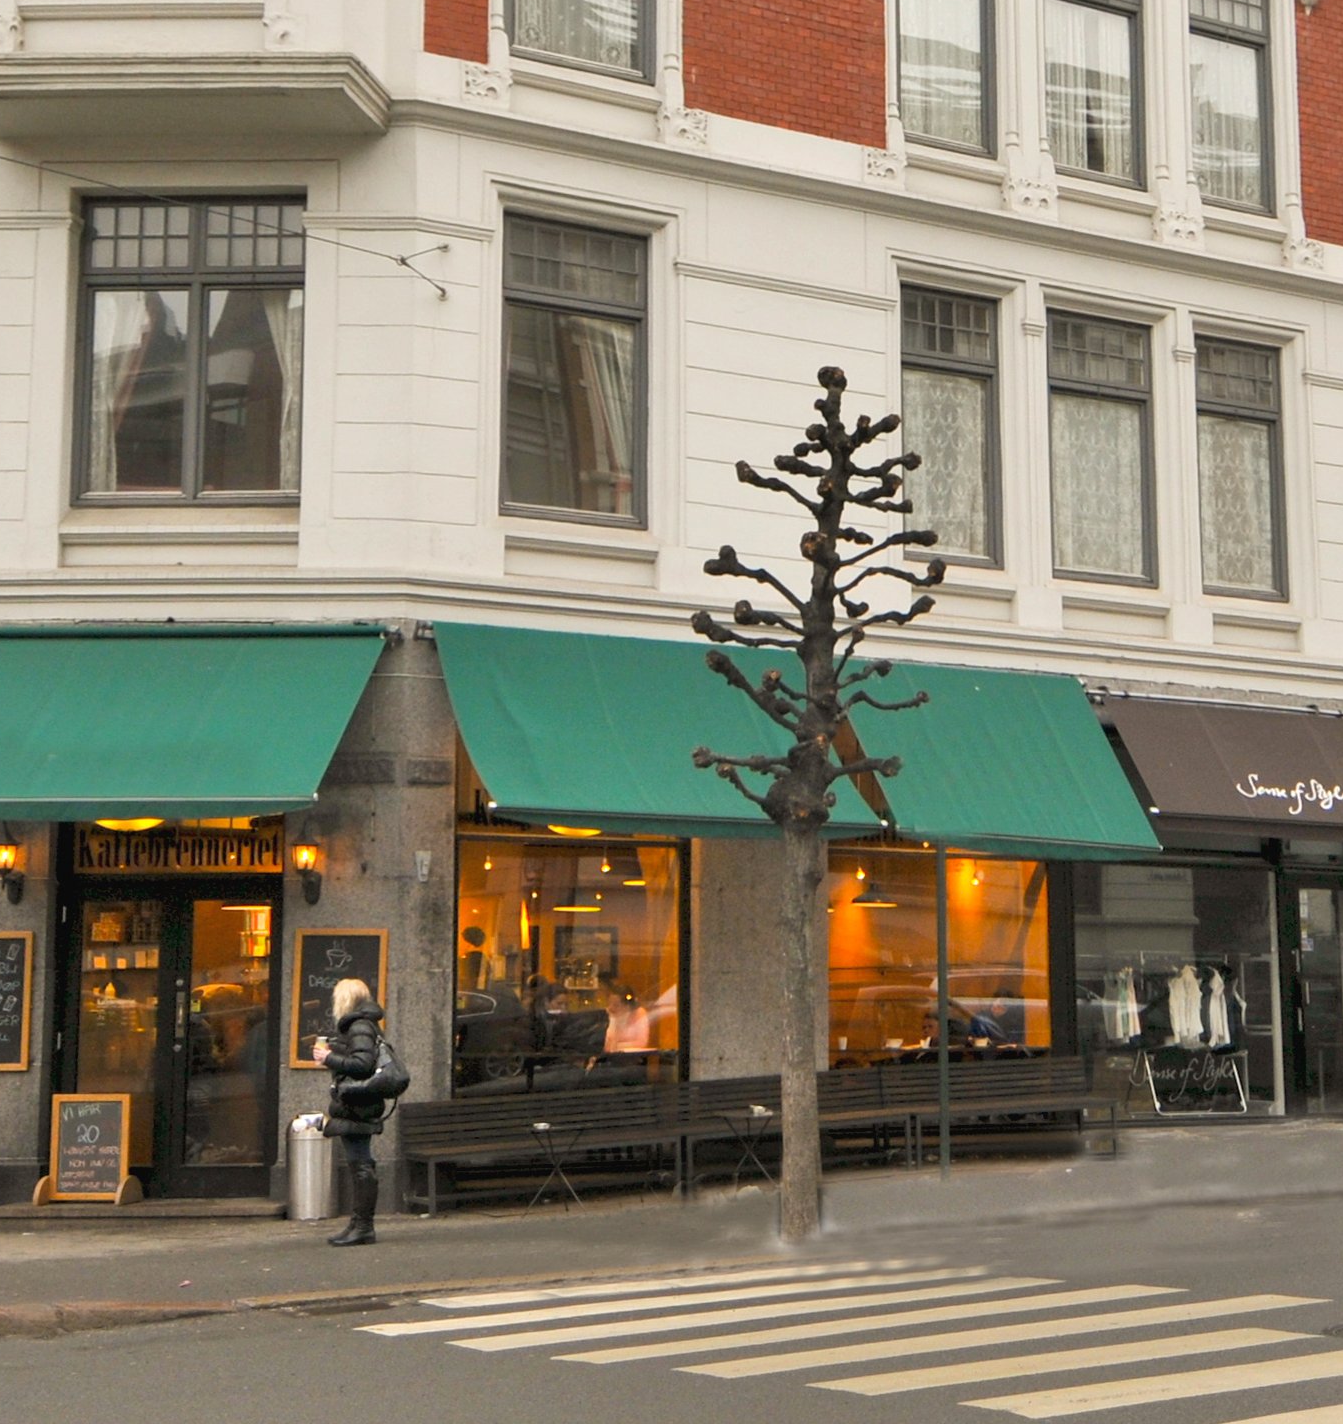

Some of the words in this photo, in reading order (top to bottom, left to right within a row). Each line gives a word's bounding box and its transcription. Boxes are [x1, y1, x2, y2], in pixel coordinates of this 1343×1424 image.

[1289, 782, 1305, 815] of
[78, 828, 280, 868] Kaffebrenneriet
[77, 1123, 100, 1143] 20
